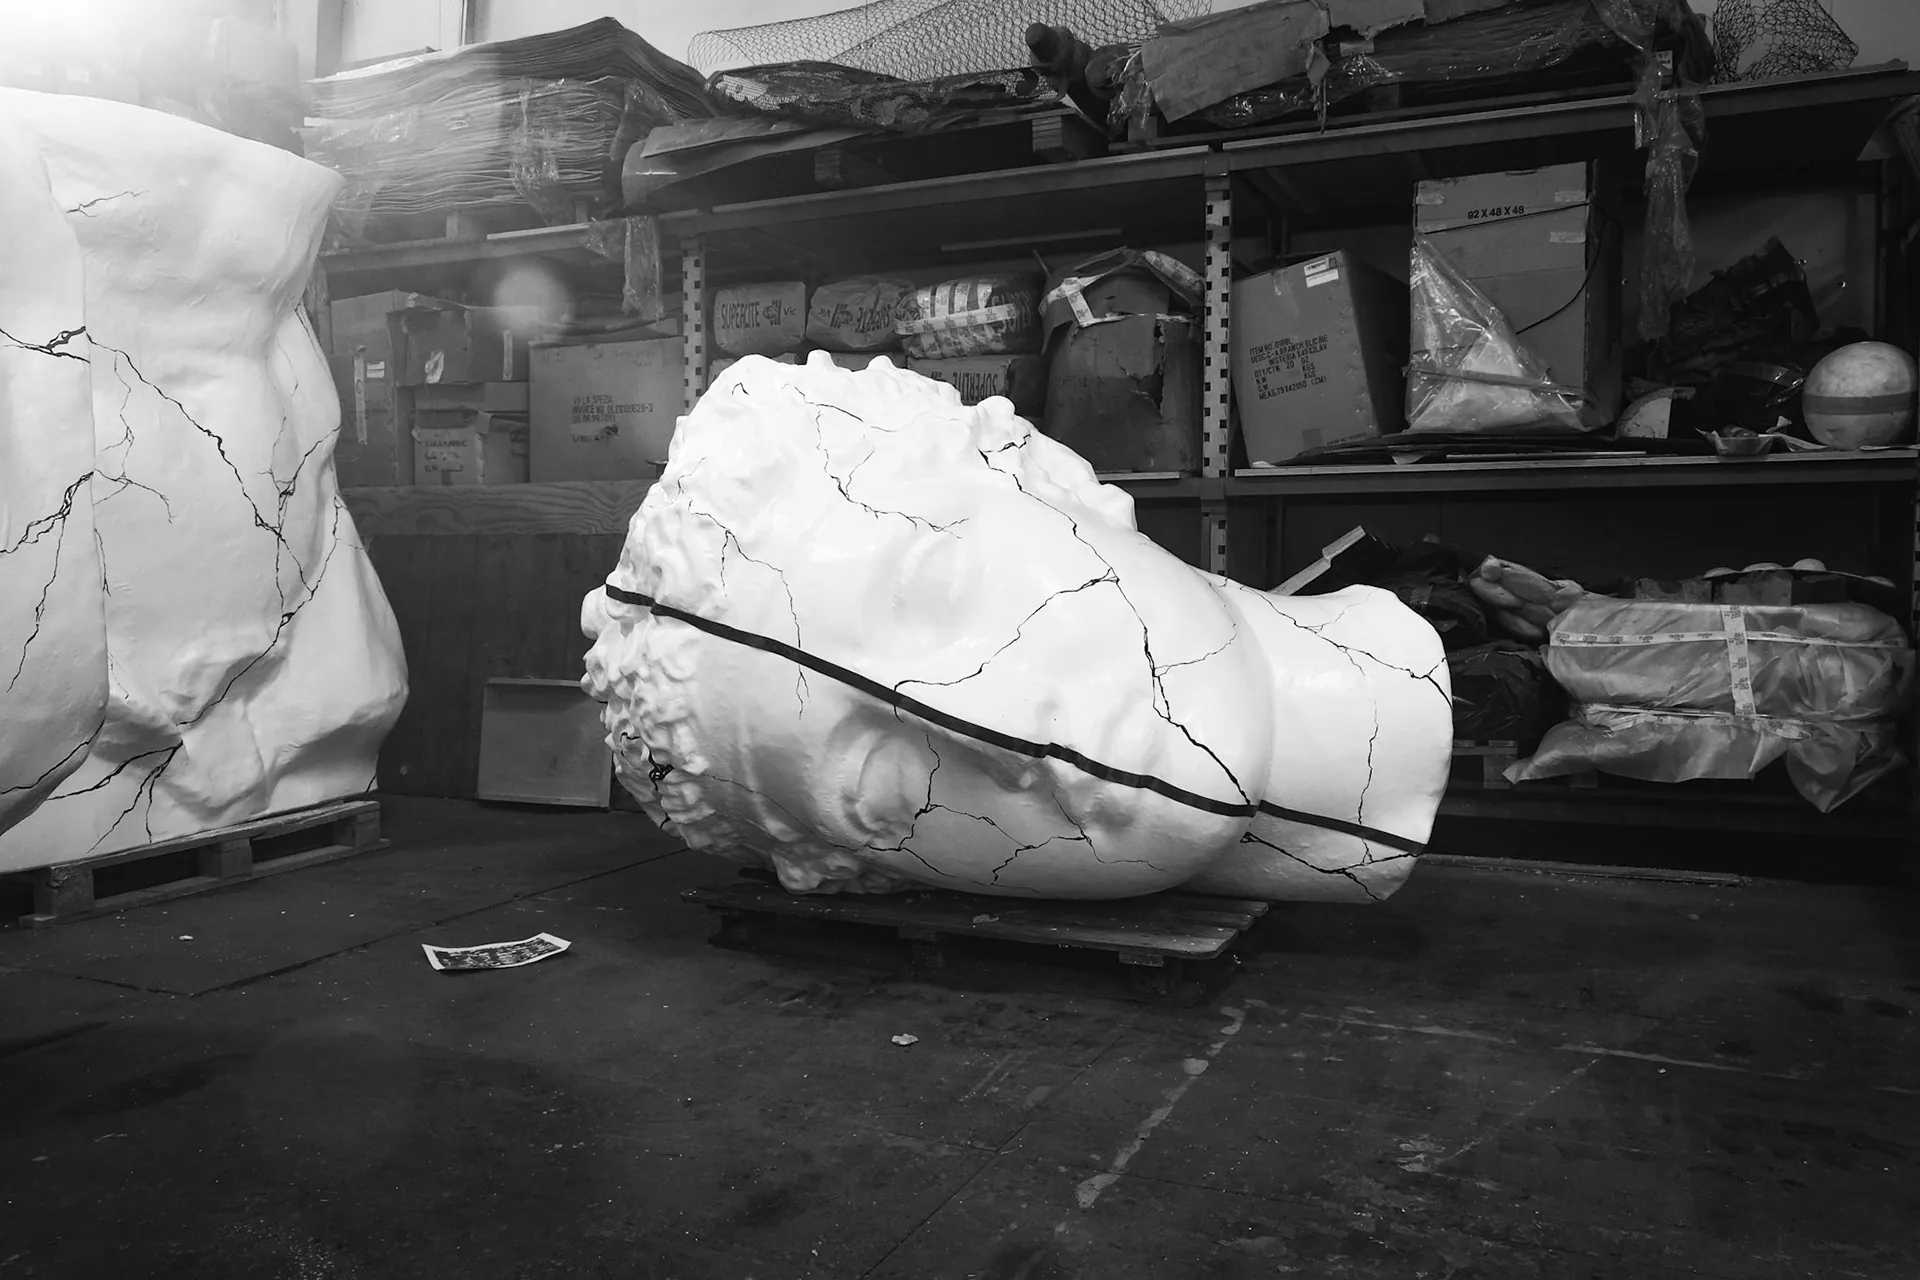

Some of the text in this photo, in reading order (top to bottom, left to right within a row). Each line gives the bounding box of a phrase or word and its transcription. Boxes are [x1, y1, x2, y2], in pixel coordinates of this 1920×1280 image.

[1468, 205, 1525, 219] 92 X 48 X 48
[721, 301, 760, 330] SUPERLITE
[1249, 345, 1264, 356] ITEM
[1279, 341, 1304, 355] BRANCH
[1268, 353, 1296, 366] WISTERIA
[1302, 362, 1315, 373] KGS
[1304, 370, 1316, 379] KGS
